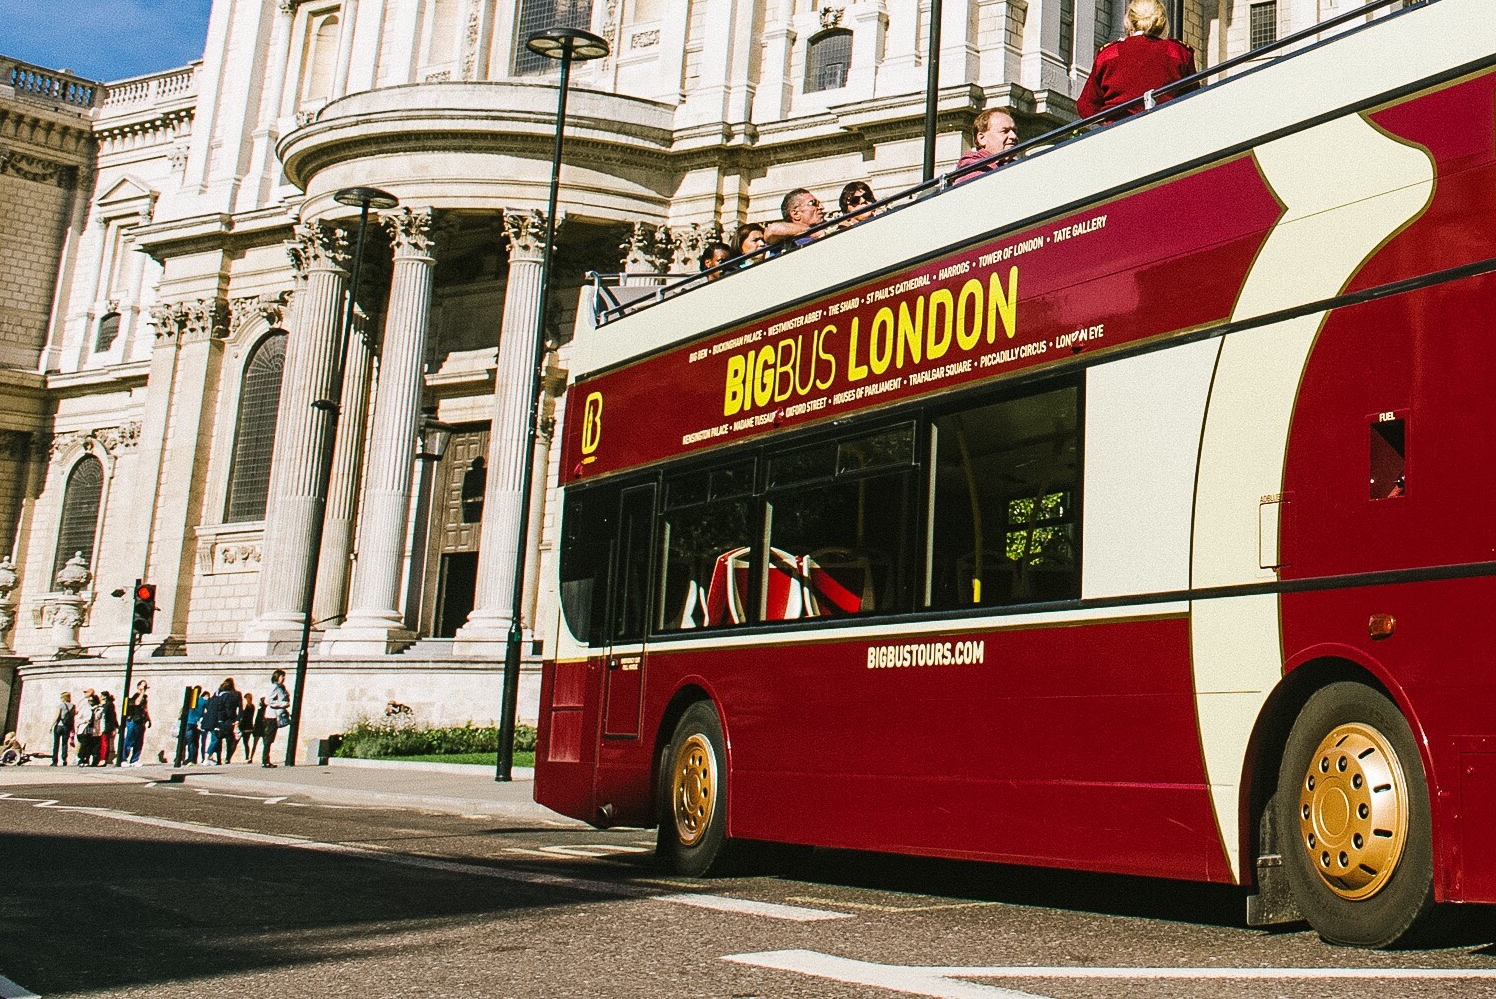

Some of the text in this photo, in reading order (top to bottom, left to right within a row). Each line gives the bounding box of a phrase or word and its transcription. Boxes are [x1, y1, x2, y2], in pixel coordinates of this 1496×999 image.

[744, 330, 763, 344] PALACE
[768, 314, 804, 336] WESTMINSTER
[828, 303, 840, 316] THE
[840, 297, 860, 312] SHARD
[866, 292, 875, 305] ST
[874, 285, 894, 302] PAUL'S
[895, 274, 930, 294] CATHEDRAL
[938, 260, 970, 280] HARRODS
[978, 250, 1002, 268] TOWER
[1002, 246, 1013, 260] OF
[1013, 236, 1044, 257] LONDON
[1052, 226, 1072, 244] TATE
[1072, 214, 1108, 236] GALLERY
[848, 265, 1019, 382] LONDON
[710, 424, 729, 437] PALACE
[806, 396, 827, 412] STREET
[833, 388, 856, 406] HOUSES
[856, 386, 864, 400] OF
[864, 377, 902, 397] PARLIAMENT
[908, 366, 944, 386] TRAFALGAR
[944, 359, 972, 376] SQUARE
[980, 346, 1020, 368] PICCADILLY
[1020, 340, 1046, 358] CIRCUS
[1088, 324, 1105, 340] EYE
[1379, 412, 1396, 422] FUEL
[867, 640, 984, 668] BIGBUSTOURS.COM
